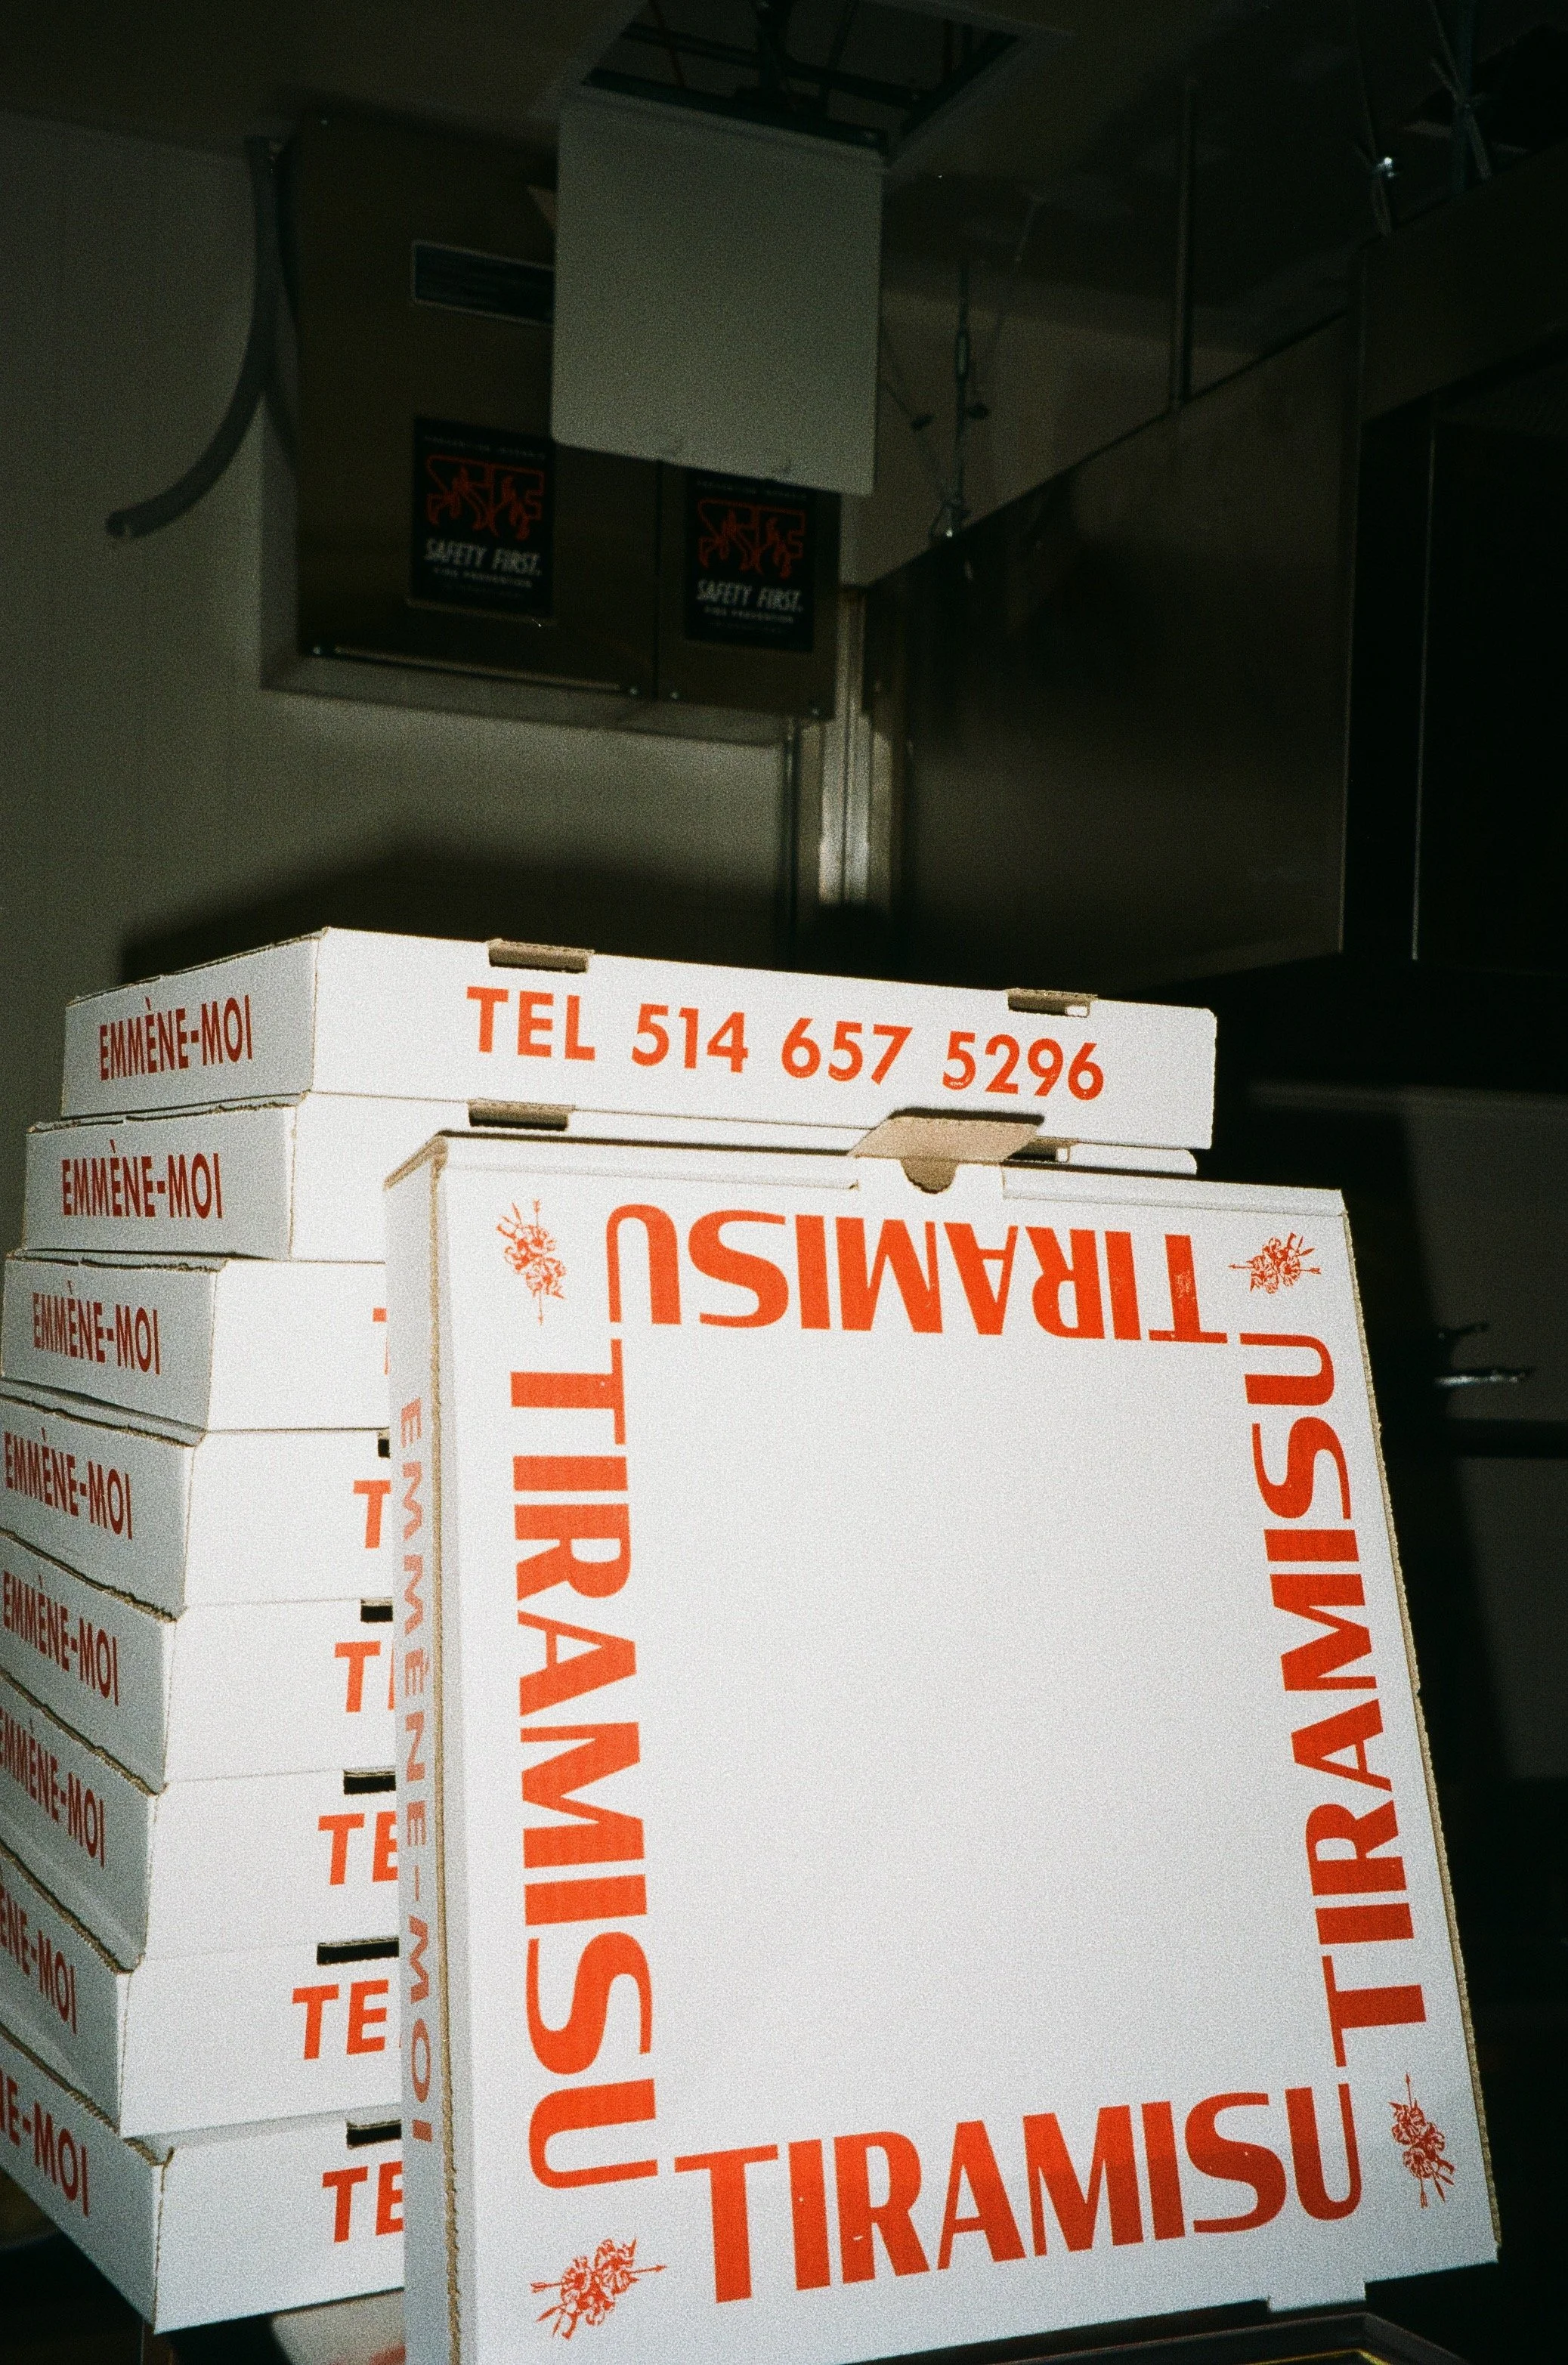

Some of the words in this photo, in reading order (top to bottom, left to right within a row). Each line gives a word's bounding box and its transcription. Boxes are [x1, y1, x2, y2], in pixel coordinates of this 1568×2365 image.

[424, 537, 487, 567] SAFETY
[695, 578, 753, 607] SAFETY
[100, 996, 252, 1080] EMMÈNE-MOI
[466, 986, 595, 1062] TEL
[632, 1003, 749, 1073] 514
[781, 1018, 912, 1085] 657
[942, 1031, 1104, 1101] 5296
[62, 1139, 222, 1219] EMMÈNE-MOI
[606, 1204, 1228, 1344] TIRAMISU
[32, 1281, 160, 1374] EMMÈNE-MOI
[4, 1427, 132, 1540] EMMÈNE-MOI
[3, 1570, 119, 1706] EMMÈNE-MOI
[1239, 1332, 1427, 2068] TIRAMISU
[401, 1397, 432, 2142] EMMÈNE-MOI
[510, 1339, 658, 2190] TIRAMISU
[318, 1811, 399, 1885] TE
[292, 1979, 401, 2060] TE
[322, 2160, 405, 2243] TE
[674, 2082, 1362, 2303] TIRAMISU
